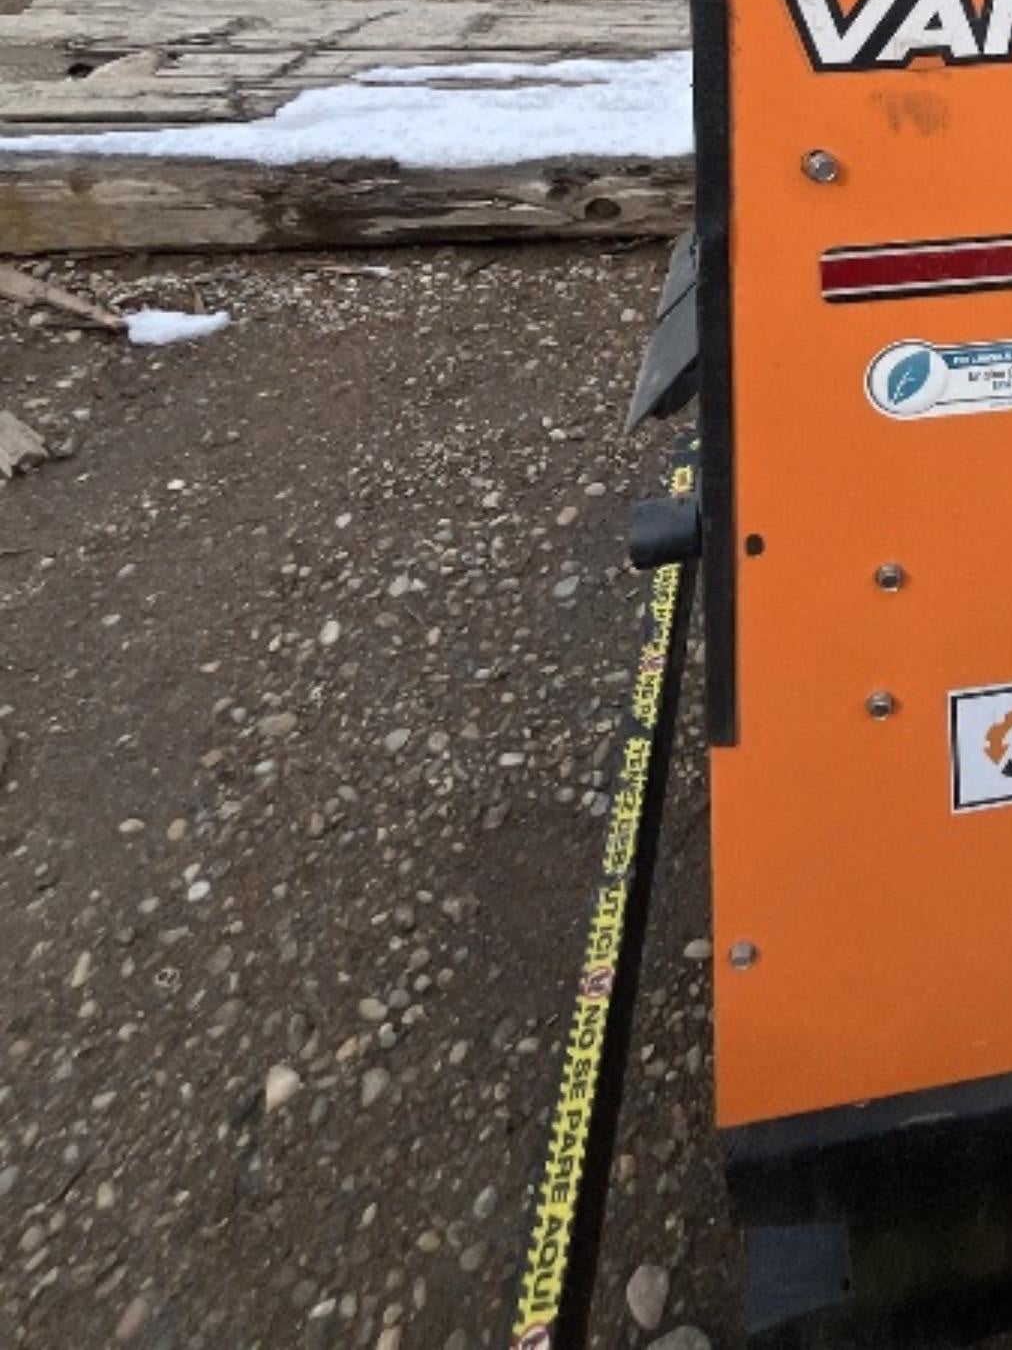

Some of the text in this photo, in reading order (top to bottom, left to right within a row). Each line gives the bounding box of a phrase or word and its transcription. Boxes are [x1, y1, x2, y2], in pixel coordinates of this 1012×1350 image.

[579, 1004, 600, 1050] NO
[569, 1058, 592, 1102] SE
[551, 1110, 582, 1203] PARE
